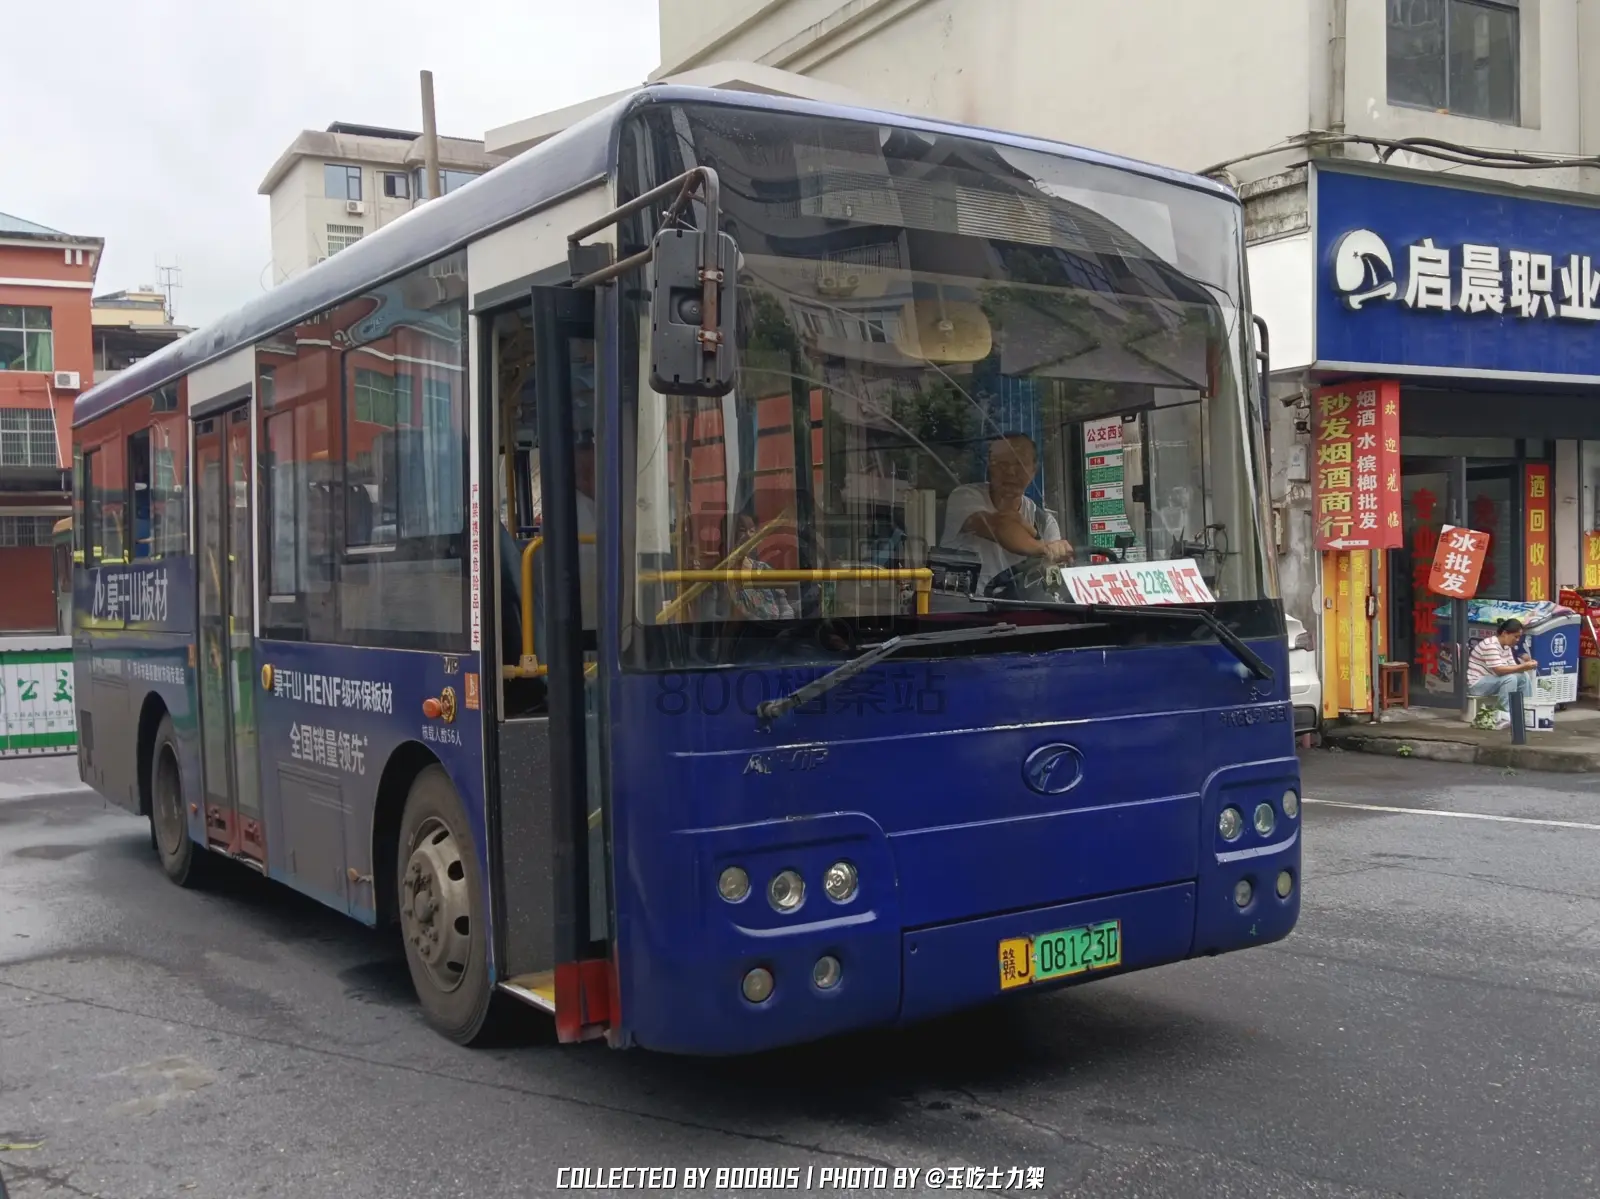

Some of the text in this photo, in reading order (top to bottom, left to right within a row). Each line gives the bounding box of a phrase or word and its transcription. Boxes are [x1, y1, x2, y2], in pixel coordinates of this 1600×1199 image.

[1403, 238, 1600, 320] 启晨职业
[1317, 392, 1354, 538] 秒发烟酒商行
[1384, 400, 1400, 528] 欢迎光临
[1439, 532, 1476, 594] 冰批发
[1530, 475, 1546, 601] 酒回收礼
[107, 568, 168, 621] 莫干山板材
[1136, 569, 1173, 595] 22路
[1584, 564, 1600, 588] 烟
[273, 669, 302, 700] 莫干山
[289, 721, 366, 776] 全国销量领先
[421, 724, 462, 747] 核载人数56人
[1003, 927, 1118, 980] 赣J 08123D
